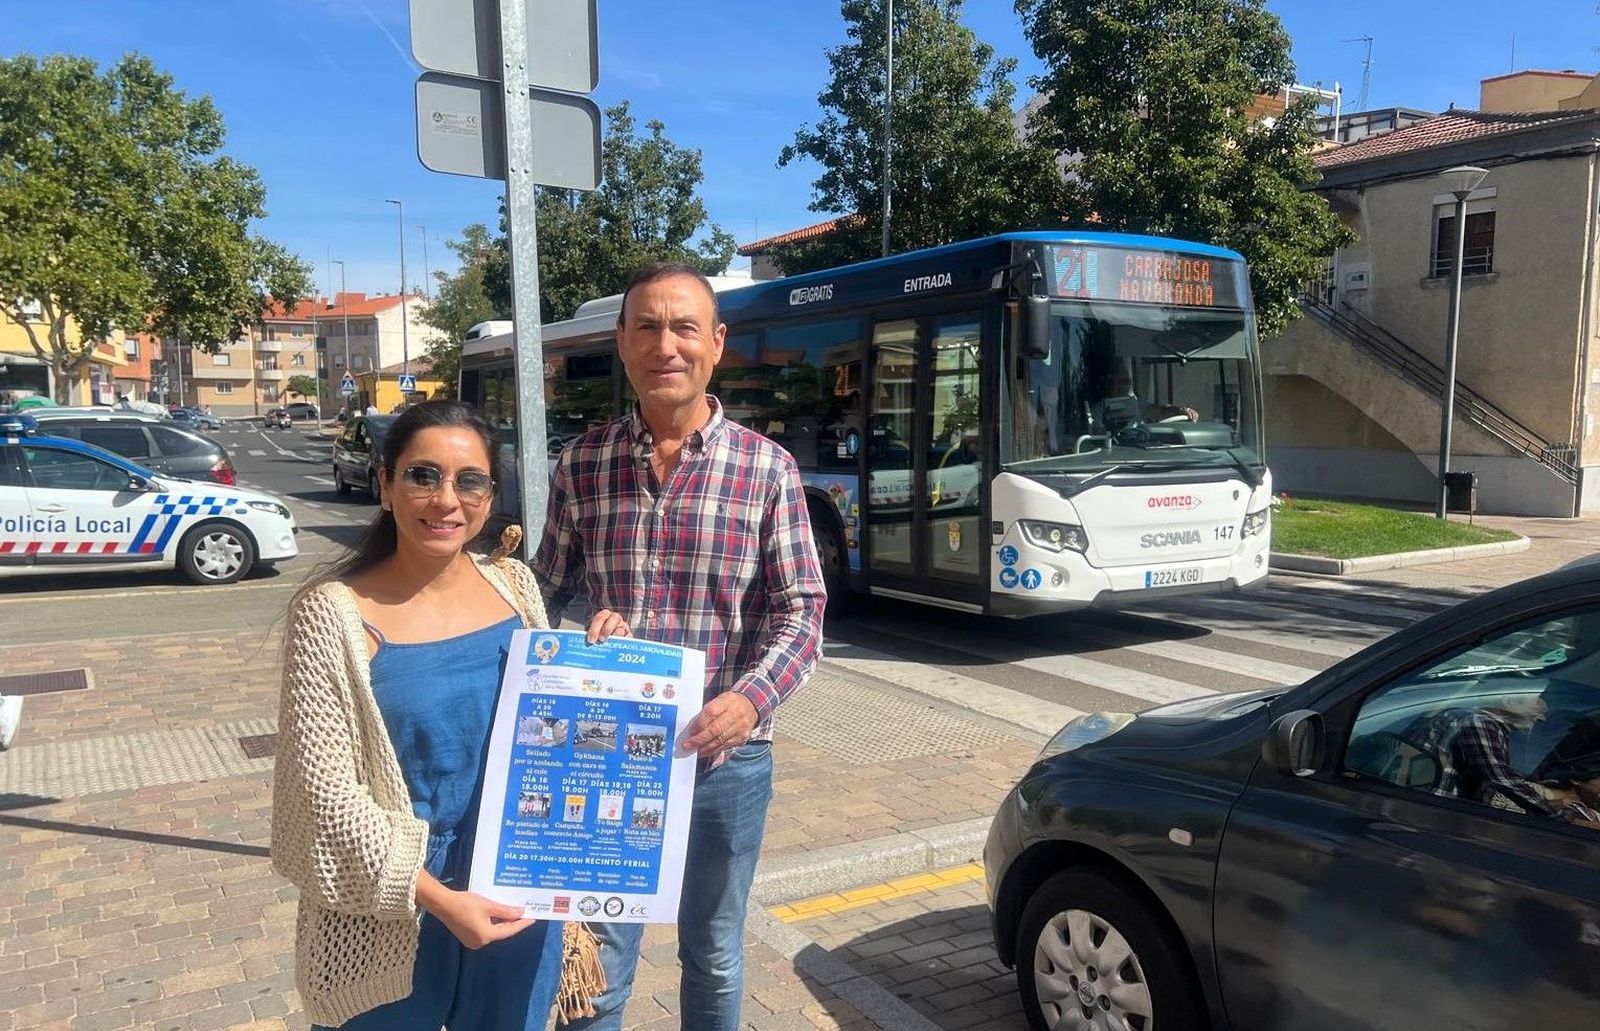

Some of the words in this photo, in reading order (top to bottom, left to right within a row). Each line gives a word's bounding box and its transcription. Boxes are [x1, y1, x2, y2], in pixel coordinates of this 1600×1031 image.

[1057, 249, 1091, 298] 21
[1125, 254, 1212, 283] CARBAJOSA
[904, 272, 952, 293] ENTRADA
[1148, 495, 1192, 508] avanza
[0, 515, 65, 532] olicía
[76, 516, 130, 533] Local
[1140, 530, 1202, 548] SCANIA
[1214, 526, 1234, 540] 147
[1153, 571, 1177, 585] 2224
[1180, 569, 1199, 582] KGD
[618, 653, 646, 664] 2024
[522, 775, 536, 783] DÍA
[504, 852, 517, 860] DÍA
[585, 858, 621, 866] RECINTO
[624, 860, 650, 868] FERIAL
